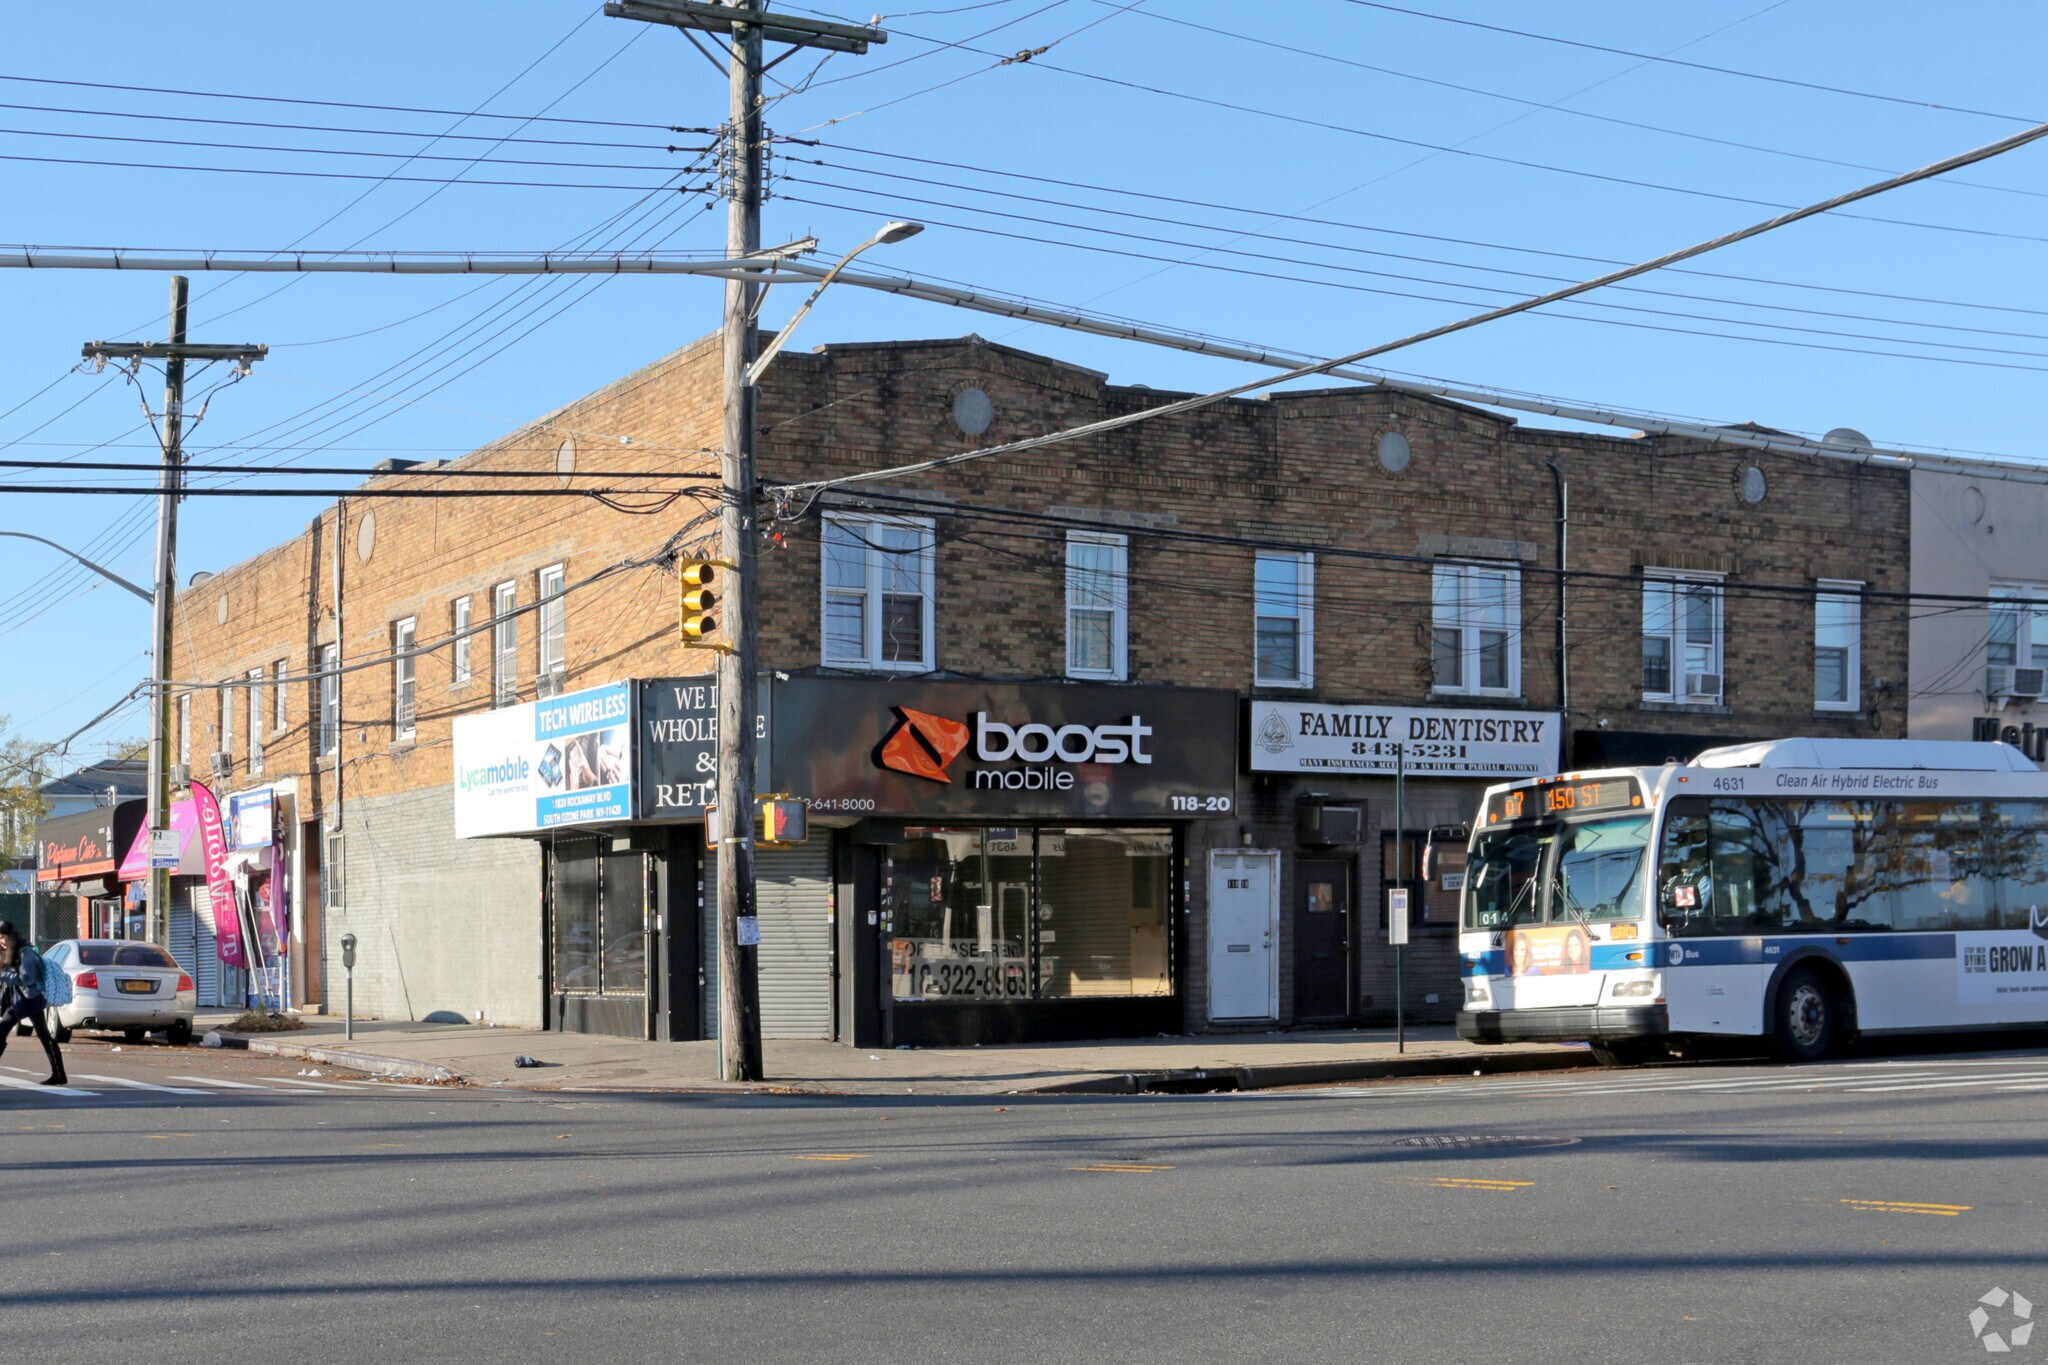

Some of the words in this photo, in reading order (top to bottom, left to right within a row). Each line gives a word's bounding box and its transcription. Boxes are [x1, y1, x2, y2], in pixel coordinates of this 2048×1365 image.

[674, 686, 706, 710] WE
[539, 706, 567, 733] TECH
[569, 693, 627, 727] WIRELESS
[1299, 712, 1393, 739] FAMILY
[1409, 717, 1544, 743] DENTISTRY
[977, 711, 1152, 764] boost
[1351, 741, 1468, 758] 843-5231
[696, 752, 719, 772] &
[1300, 758, 1324, 767] MANY
[460, 755, 530, 793] Lycamobile
[975, 766, 1074, 790] mobile
[1713, 776, 1744, 790] 4631
[1776, 773, 1808, 788] Clean
[1811, 774, 1828, 788] Air
[1831, 774, 1869, 791] Hybrid
[1873, 774, 1914, 789] Electric
[1918, 774, 1939, 789] Bus
[567, 792, 596, 808] ROCKAWAY
[597, 791, 612, 804] BLVD
[1171, 796, 1231, 811] 118-20
[1548, 786, 1576, 811] 150
[1581, 783, 1601, 807] ST
[543, 812, 561, 825] SOUTH
[561, 810, 579, 823] OZONE
[580, 808, 594, 821] PARK
[1685, 950, 1699, 958] Bus
[1764, 945, 1780, 954] 4631
[1964, 954, 1986, 966] DYING
[1989, 945, 2033, 973] GROW
[2037, 945, 2047, 972] A
